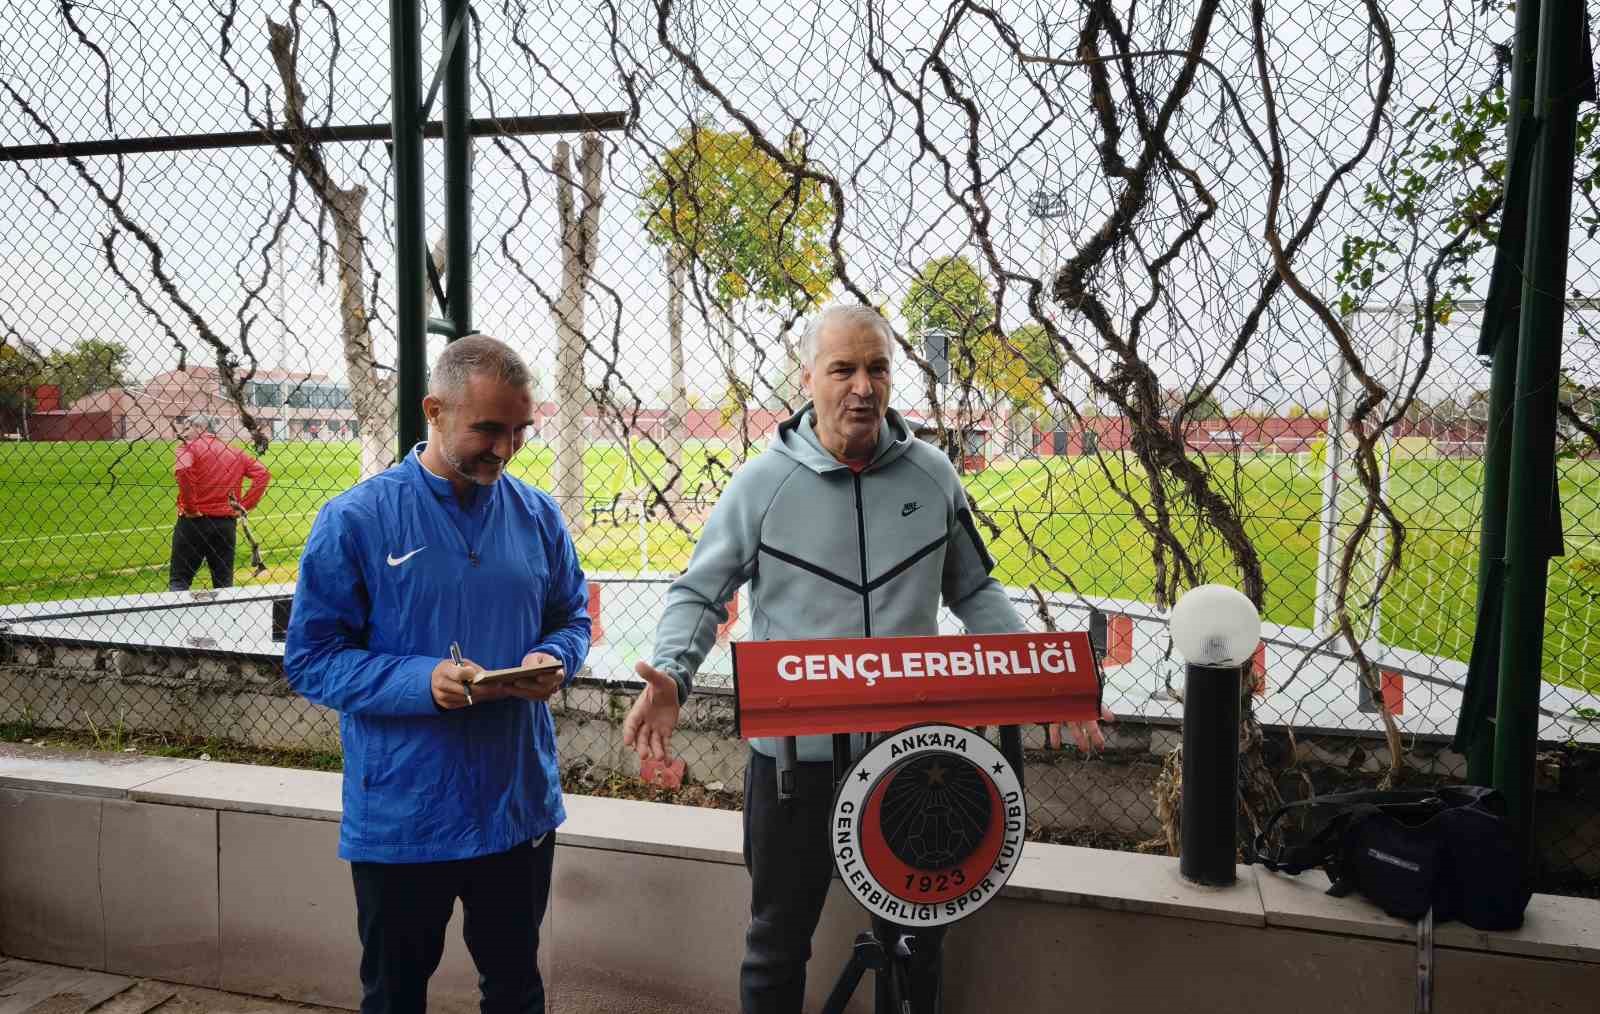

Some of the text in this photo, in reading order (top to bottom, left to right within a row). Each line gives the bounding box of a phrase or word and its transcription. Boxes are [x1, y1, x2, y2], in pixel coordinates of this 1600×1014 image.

[777, 641, 1076, 685] GENÇLERBİRLİĞİ
[890, 733, 967, 758] ANKARA
[945, 878, 995, 916] SPOR
[994, 791, 1021, 874] KULÜBÜ
[905, 868, 966, 892] 1923
